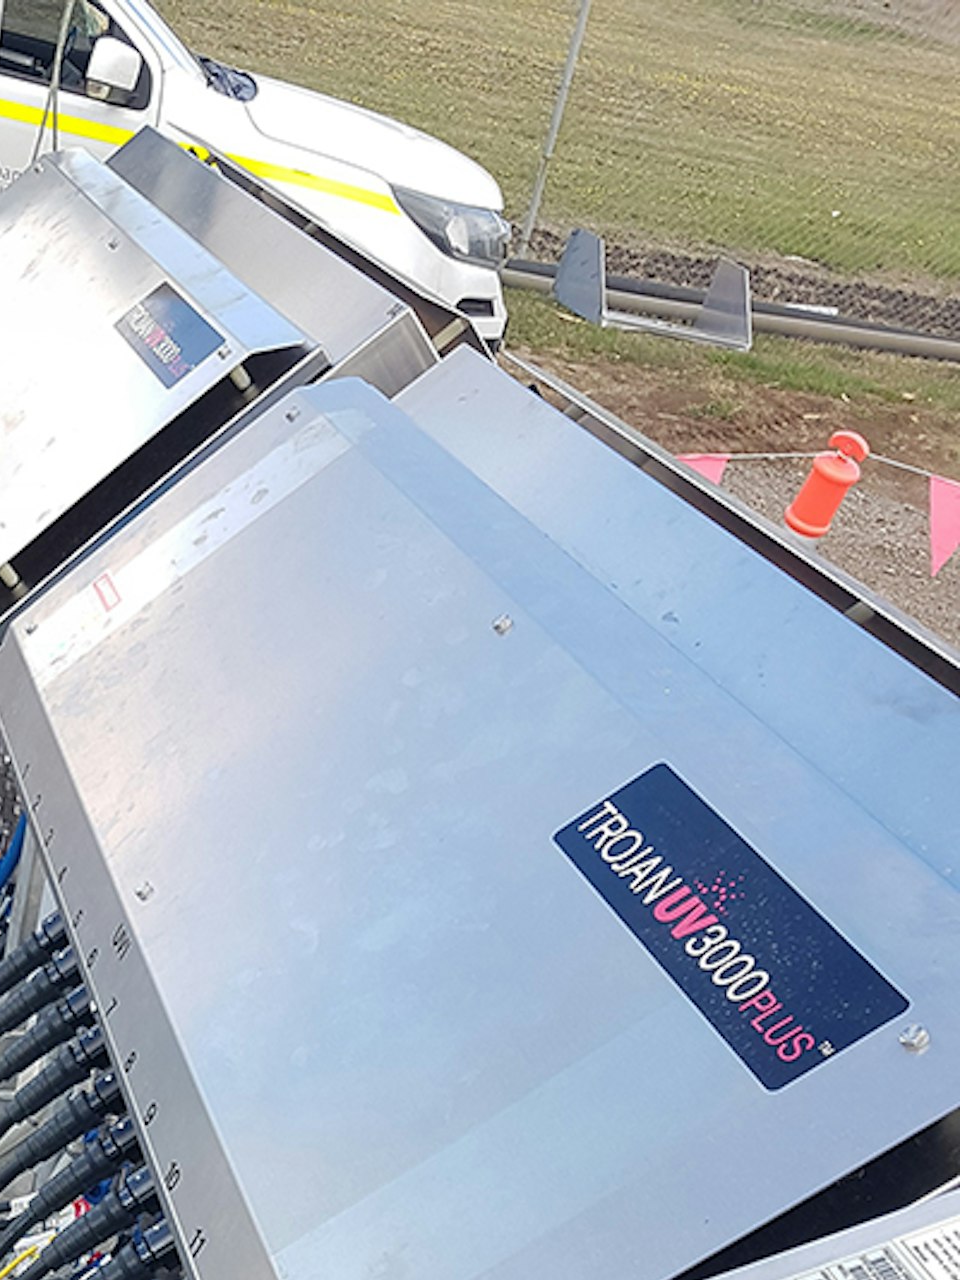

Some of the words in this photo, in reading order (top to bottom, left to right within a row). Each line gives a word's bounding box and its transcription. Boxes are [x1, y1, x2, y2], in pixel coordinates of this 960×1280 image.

[124, 1050, 137, 1073] 8
[144, 1102, 157, 1126] 9
[165, 1161, 181, 1192] 10
[189, 1228, 206, 1259] 11
